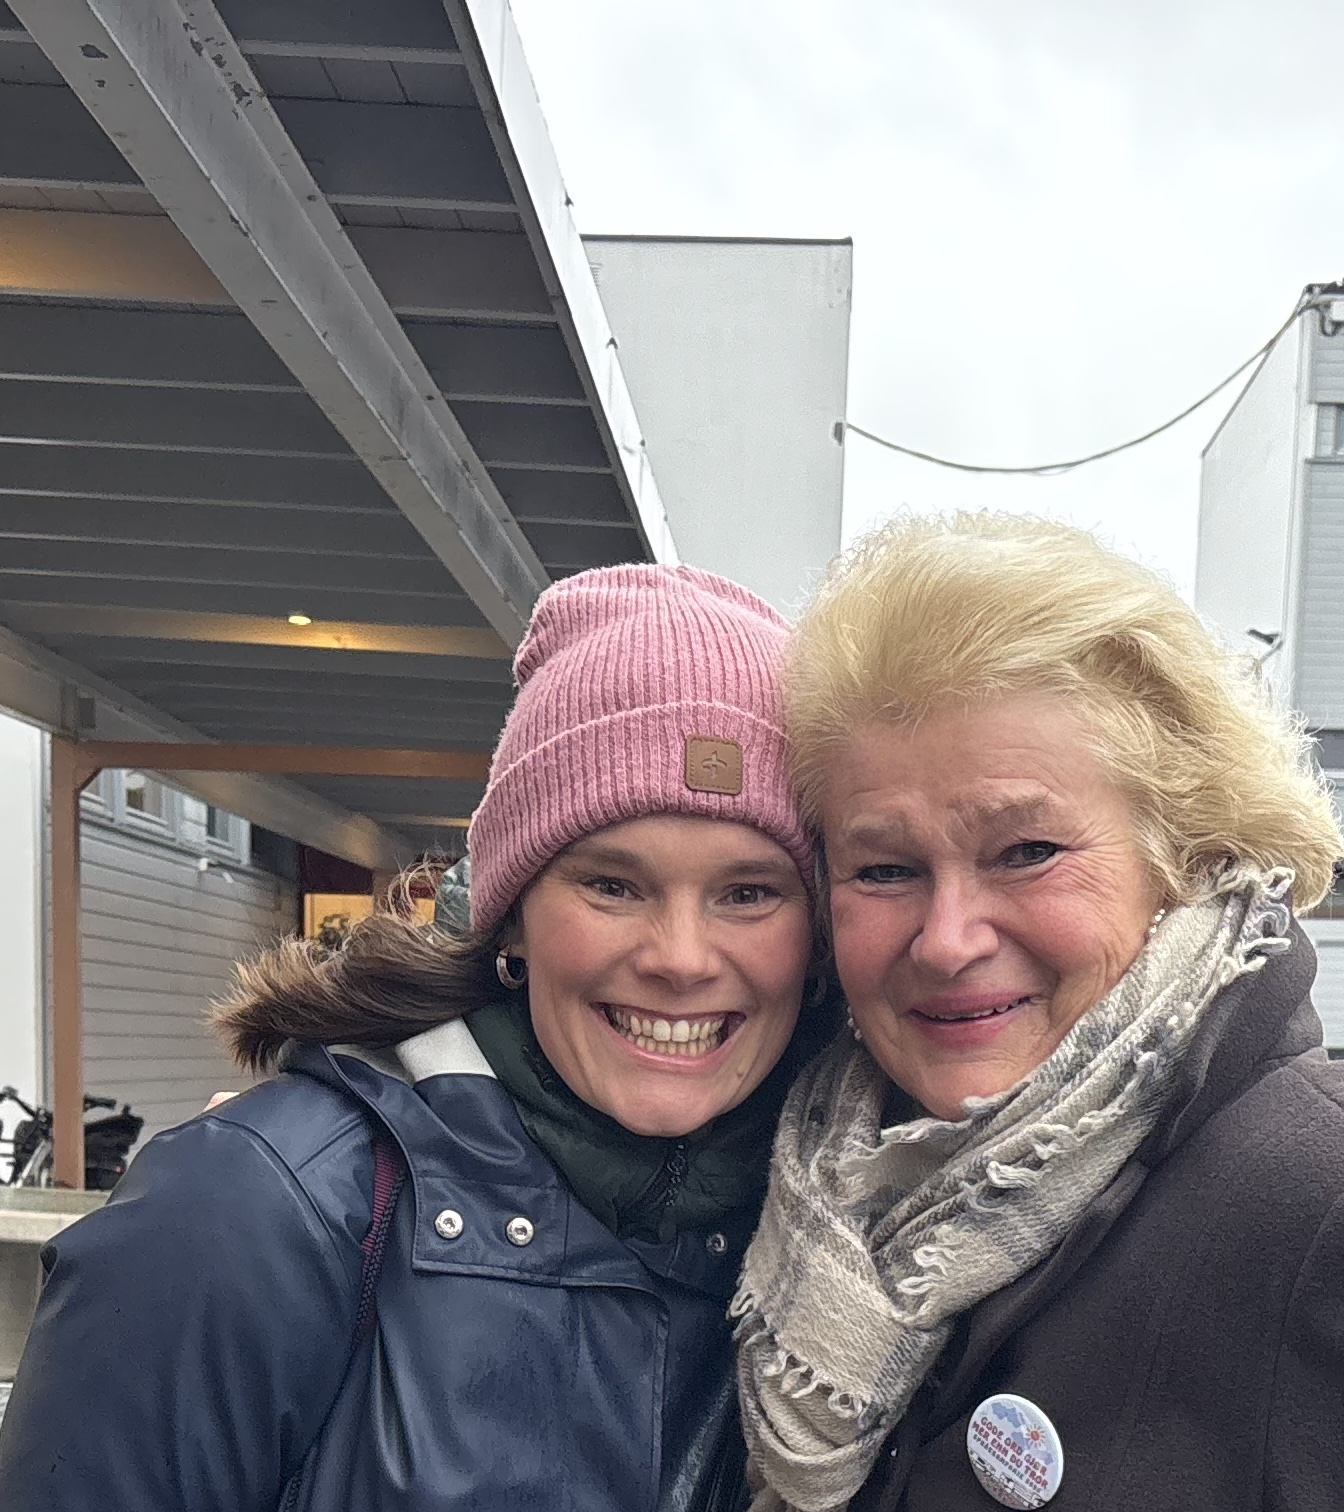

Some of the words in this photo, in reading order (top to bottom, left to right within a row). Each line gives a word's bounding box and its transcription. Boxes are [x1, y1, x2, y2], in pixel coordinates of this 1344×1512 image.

[972, 1420, 990, 1441] MER
[991, 1437, 1009, 1457] ENN
[1010, 1453, 1023, 1468] DU
[1025, 1465, 1048, 1489] TROR
[980, 1416, 1004, 1440] GODE
[1004, 1437, 1023, 1456] ORD
